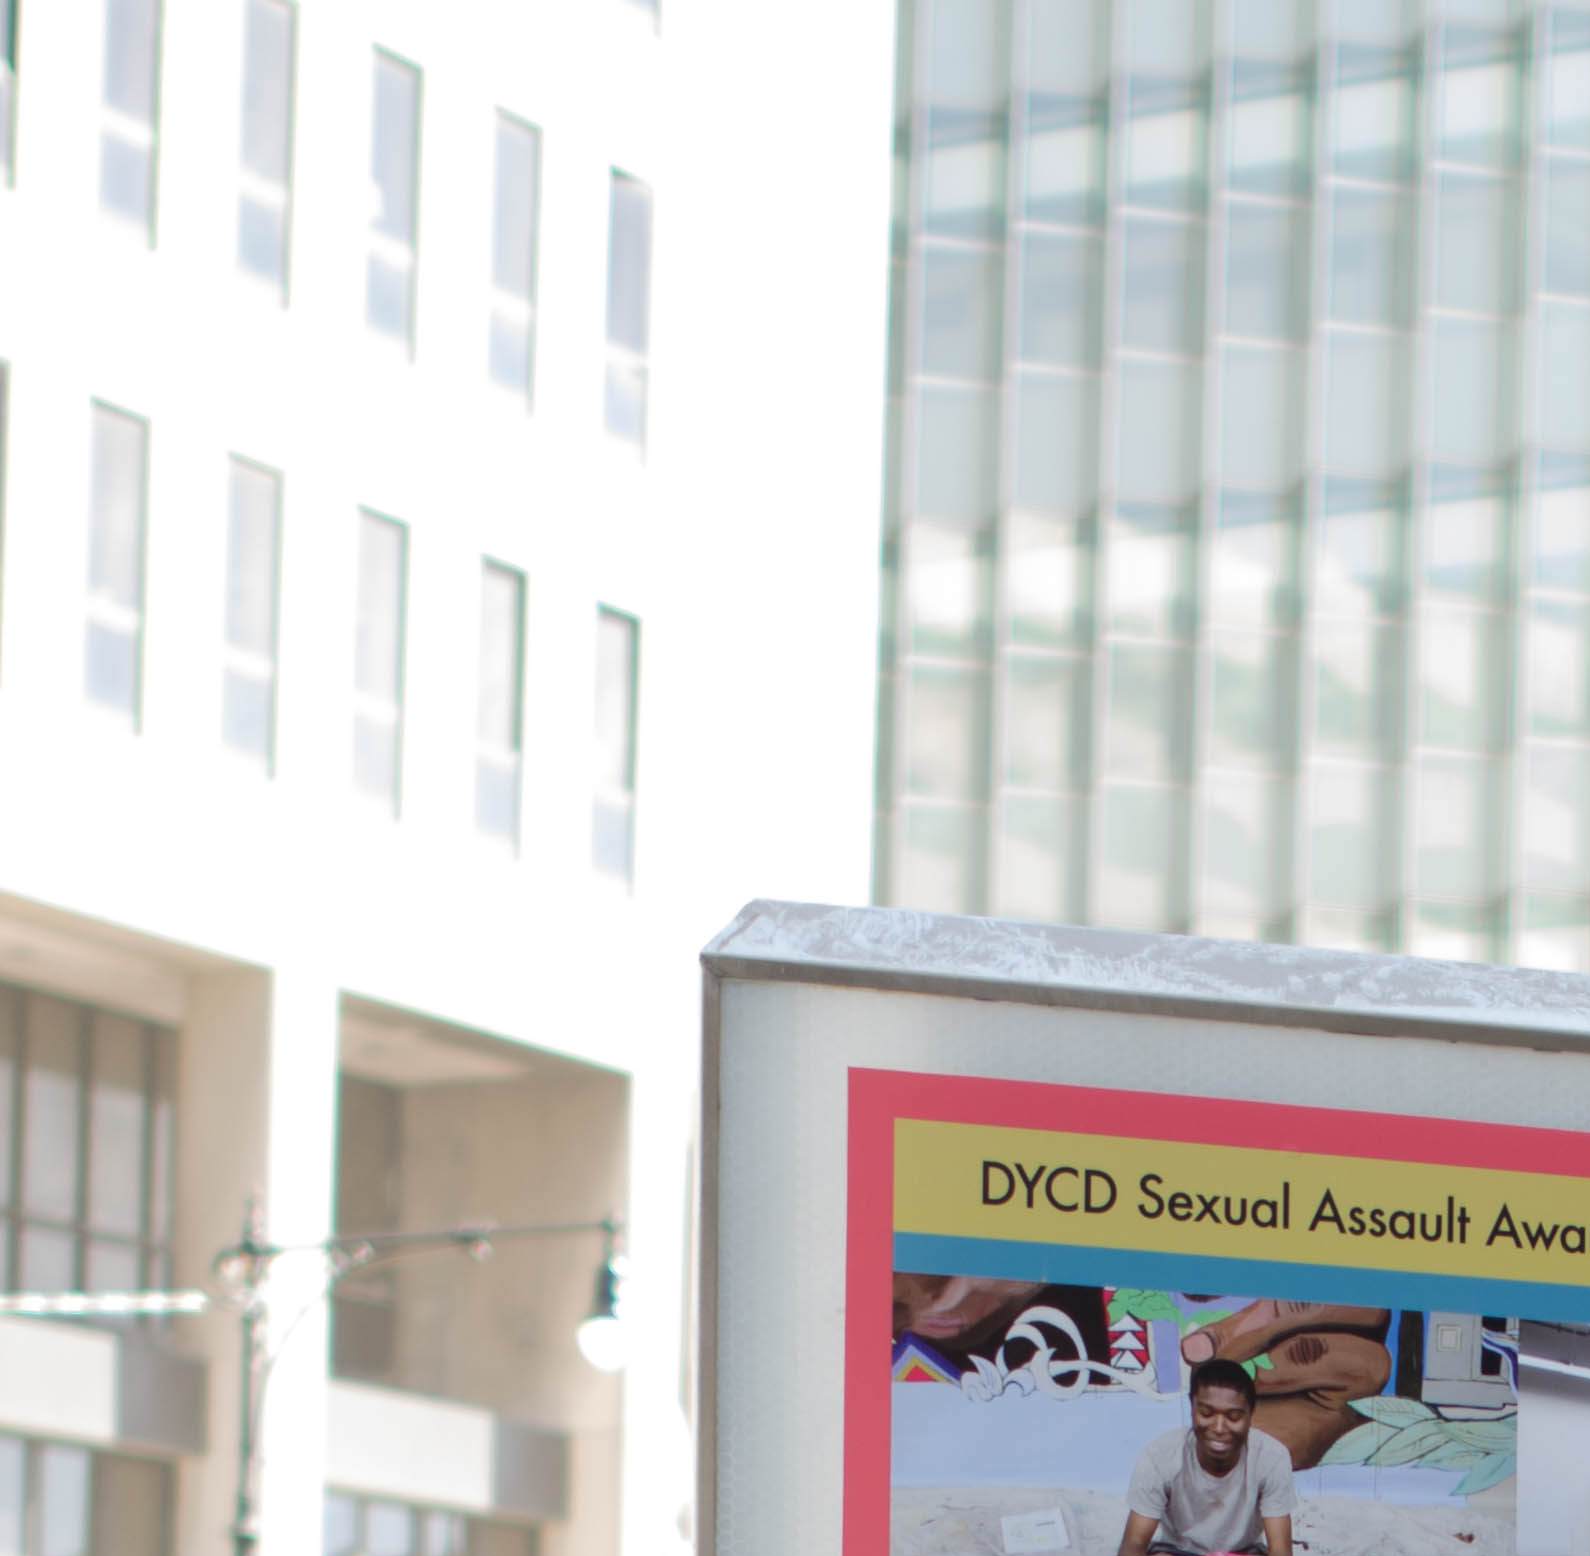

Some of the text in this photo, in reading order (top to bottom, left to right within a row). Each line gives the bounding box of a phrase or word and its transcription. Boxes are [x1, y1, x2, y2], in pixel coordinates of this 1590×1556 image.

[981, 1159, 1118, 1214] DYCD
[1137, 1172, 1291, 1230] Sexual
[1307, 1187, 1471, 1245] Assault
